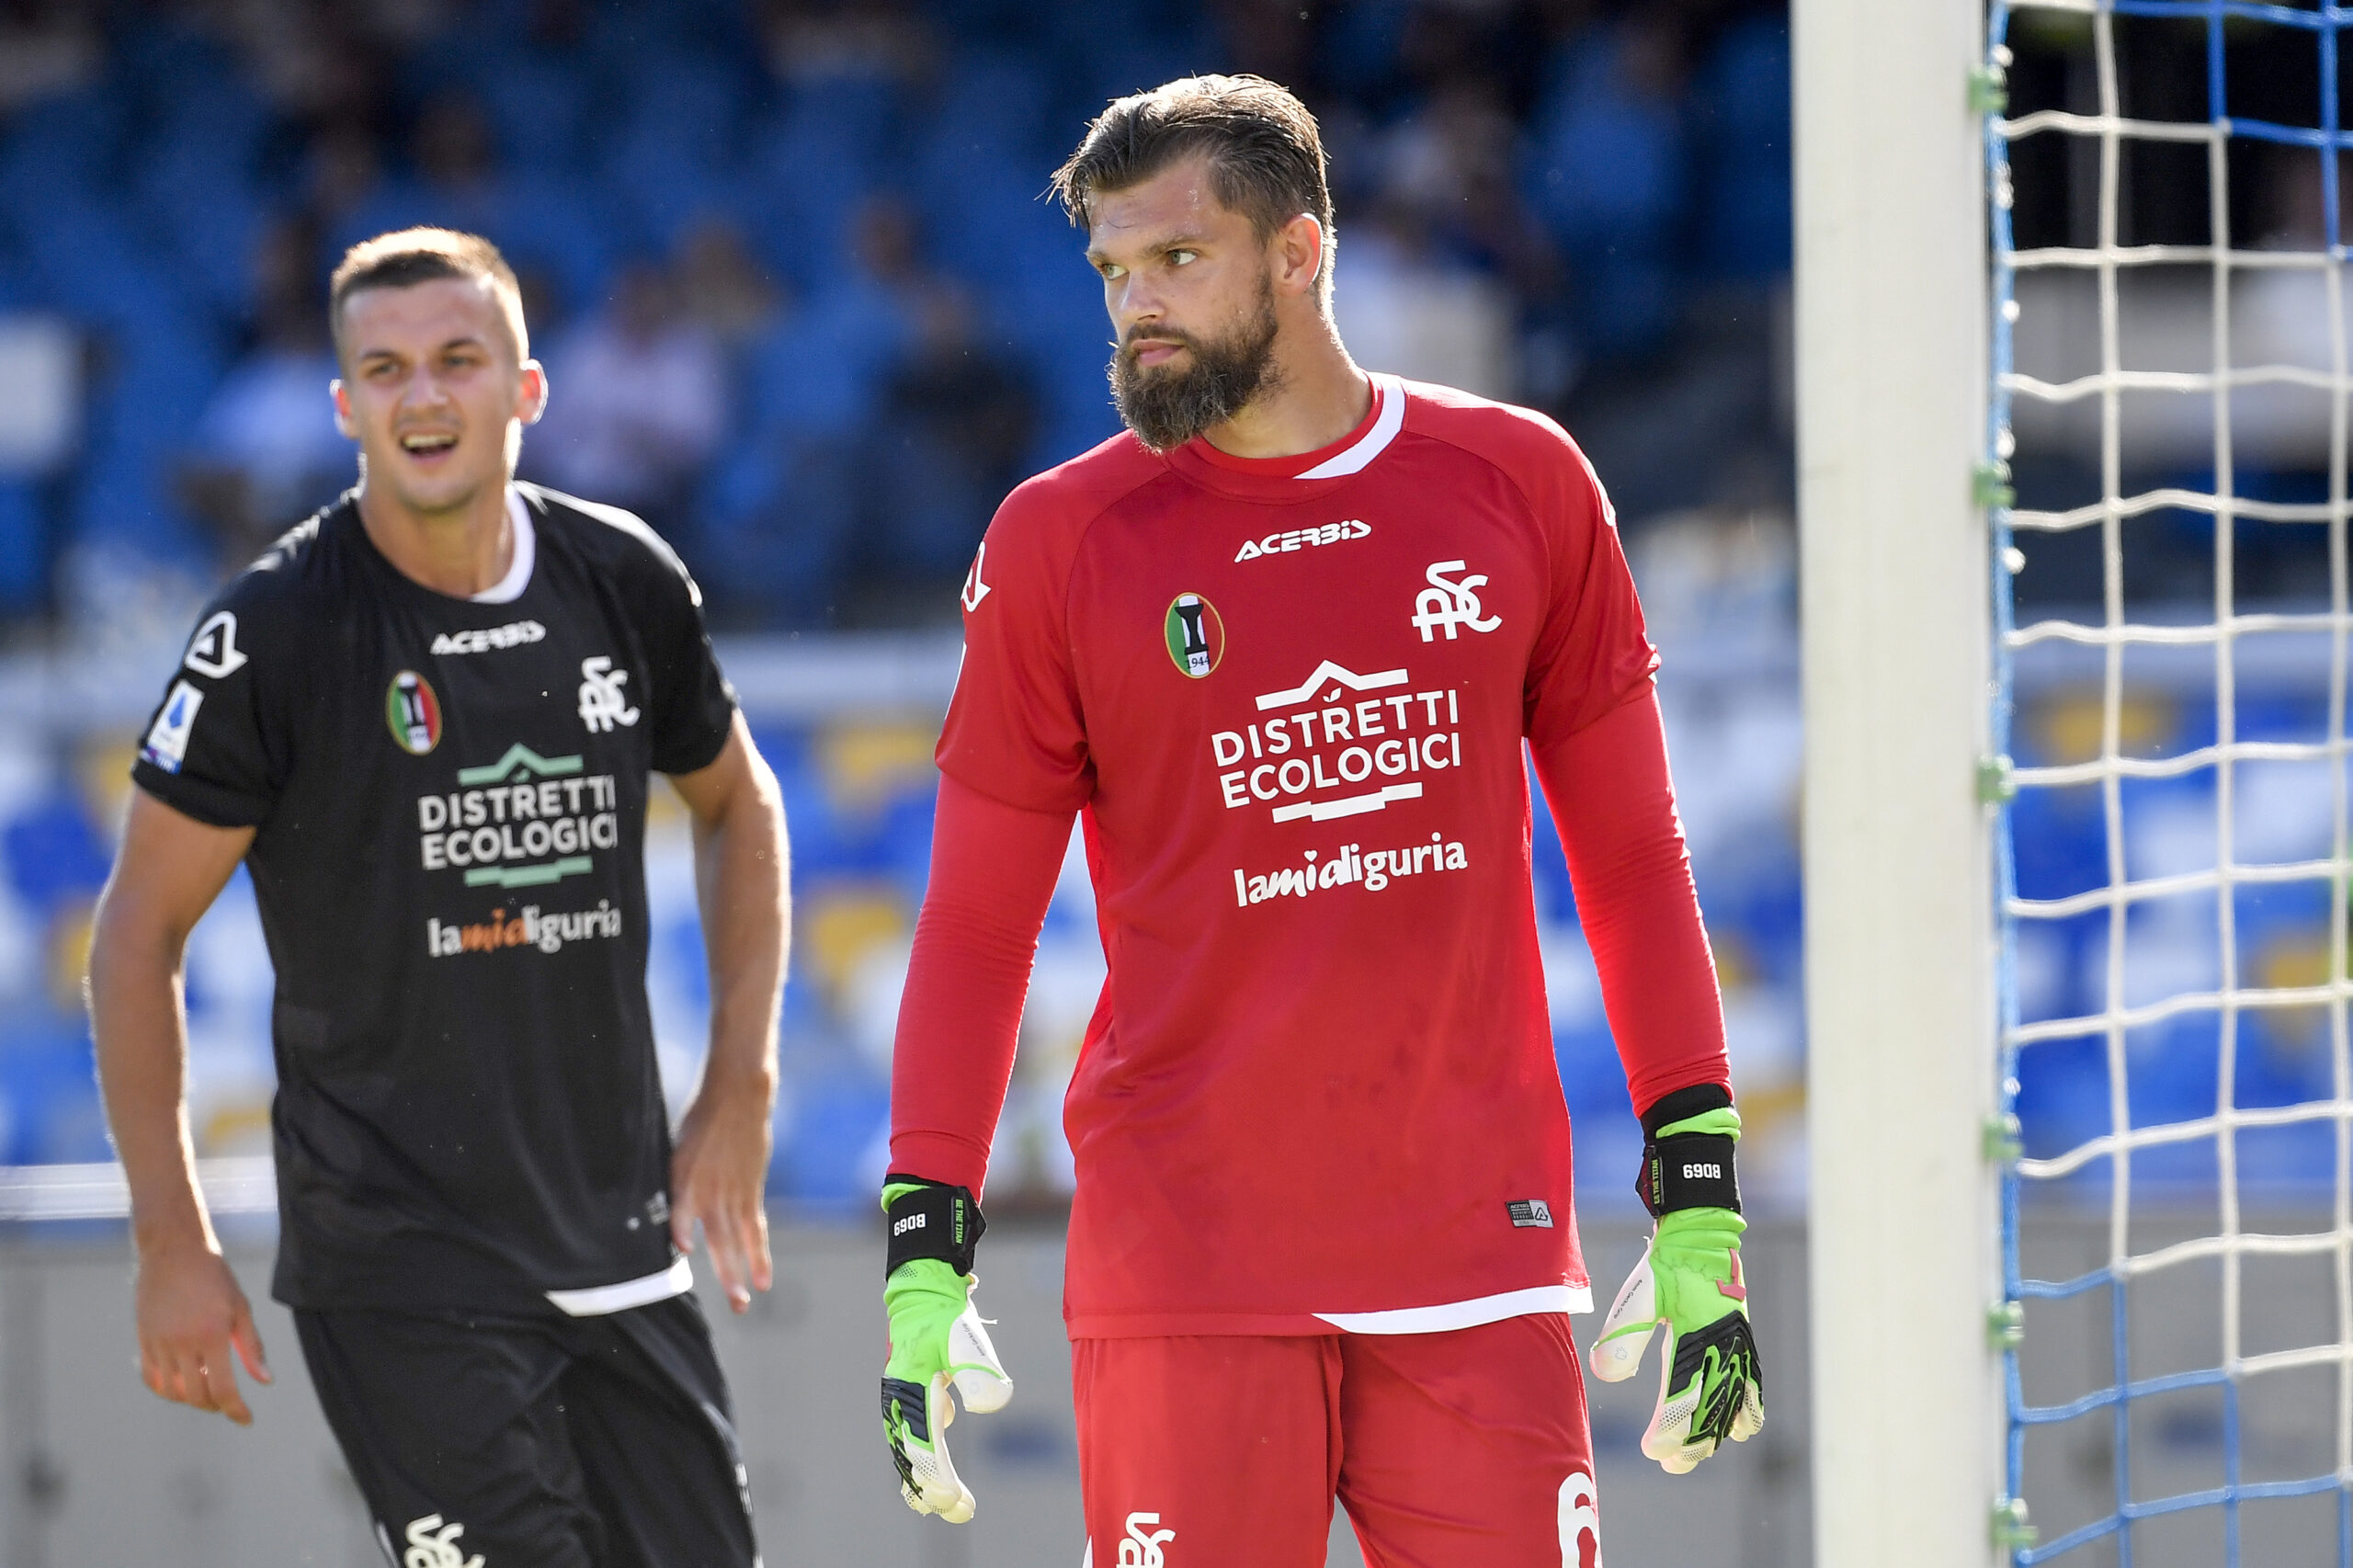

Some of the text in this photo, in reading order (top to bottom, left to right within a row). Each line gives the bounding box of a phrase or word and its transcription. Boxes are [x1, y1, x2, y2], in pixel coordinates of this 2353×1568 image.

[1233, 518, 1372, 563] ACERBIS
[1211, 689, 1459, 767] DISTRETTI
[1220, 733, 1461, 809] ECOLOGICI
[418, 774, 616, 832] DISTRETTI
[421, 812, 618, 870] ECOLOGICI
